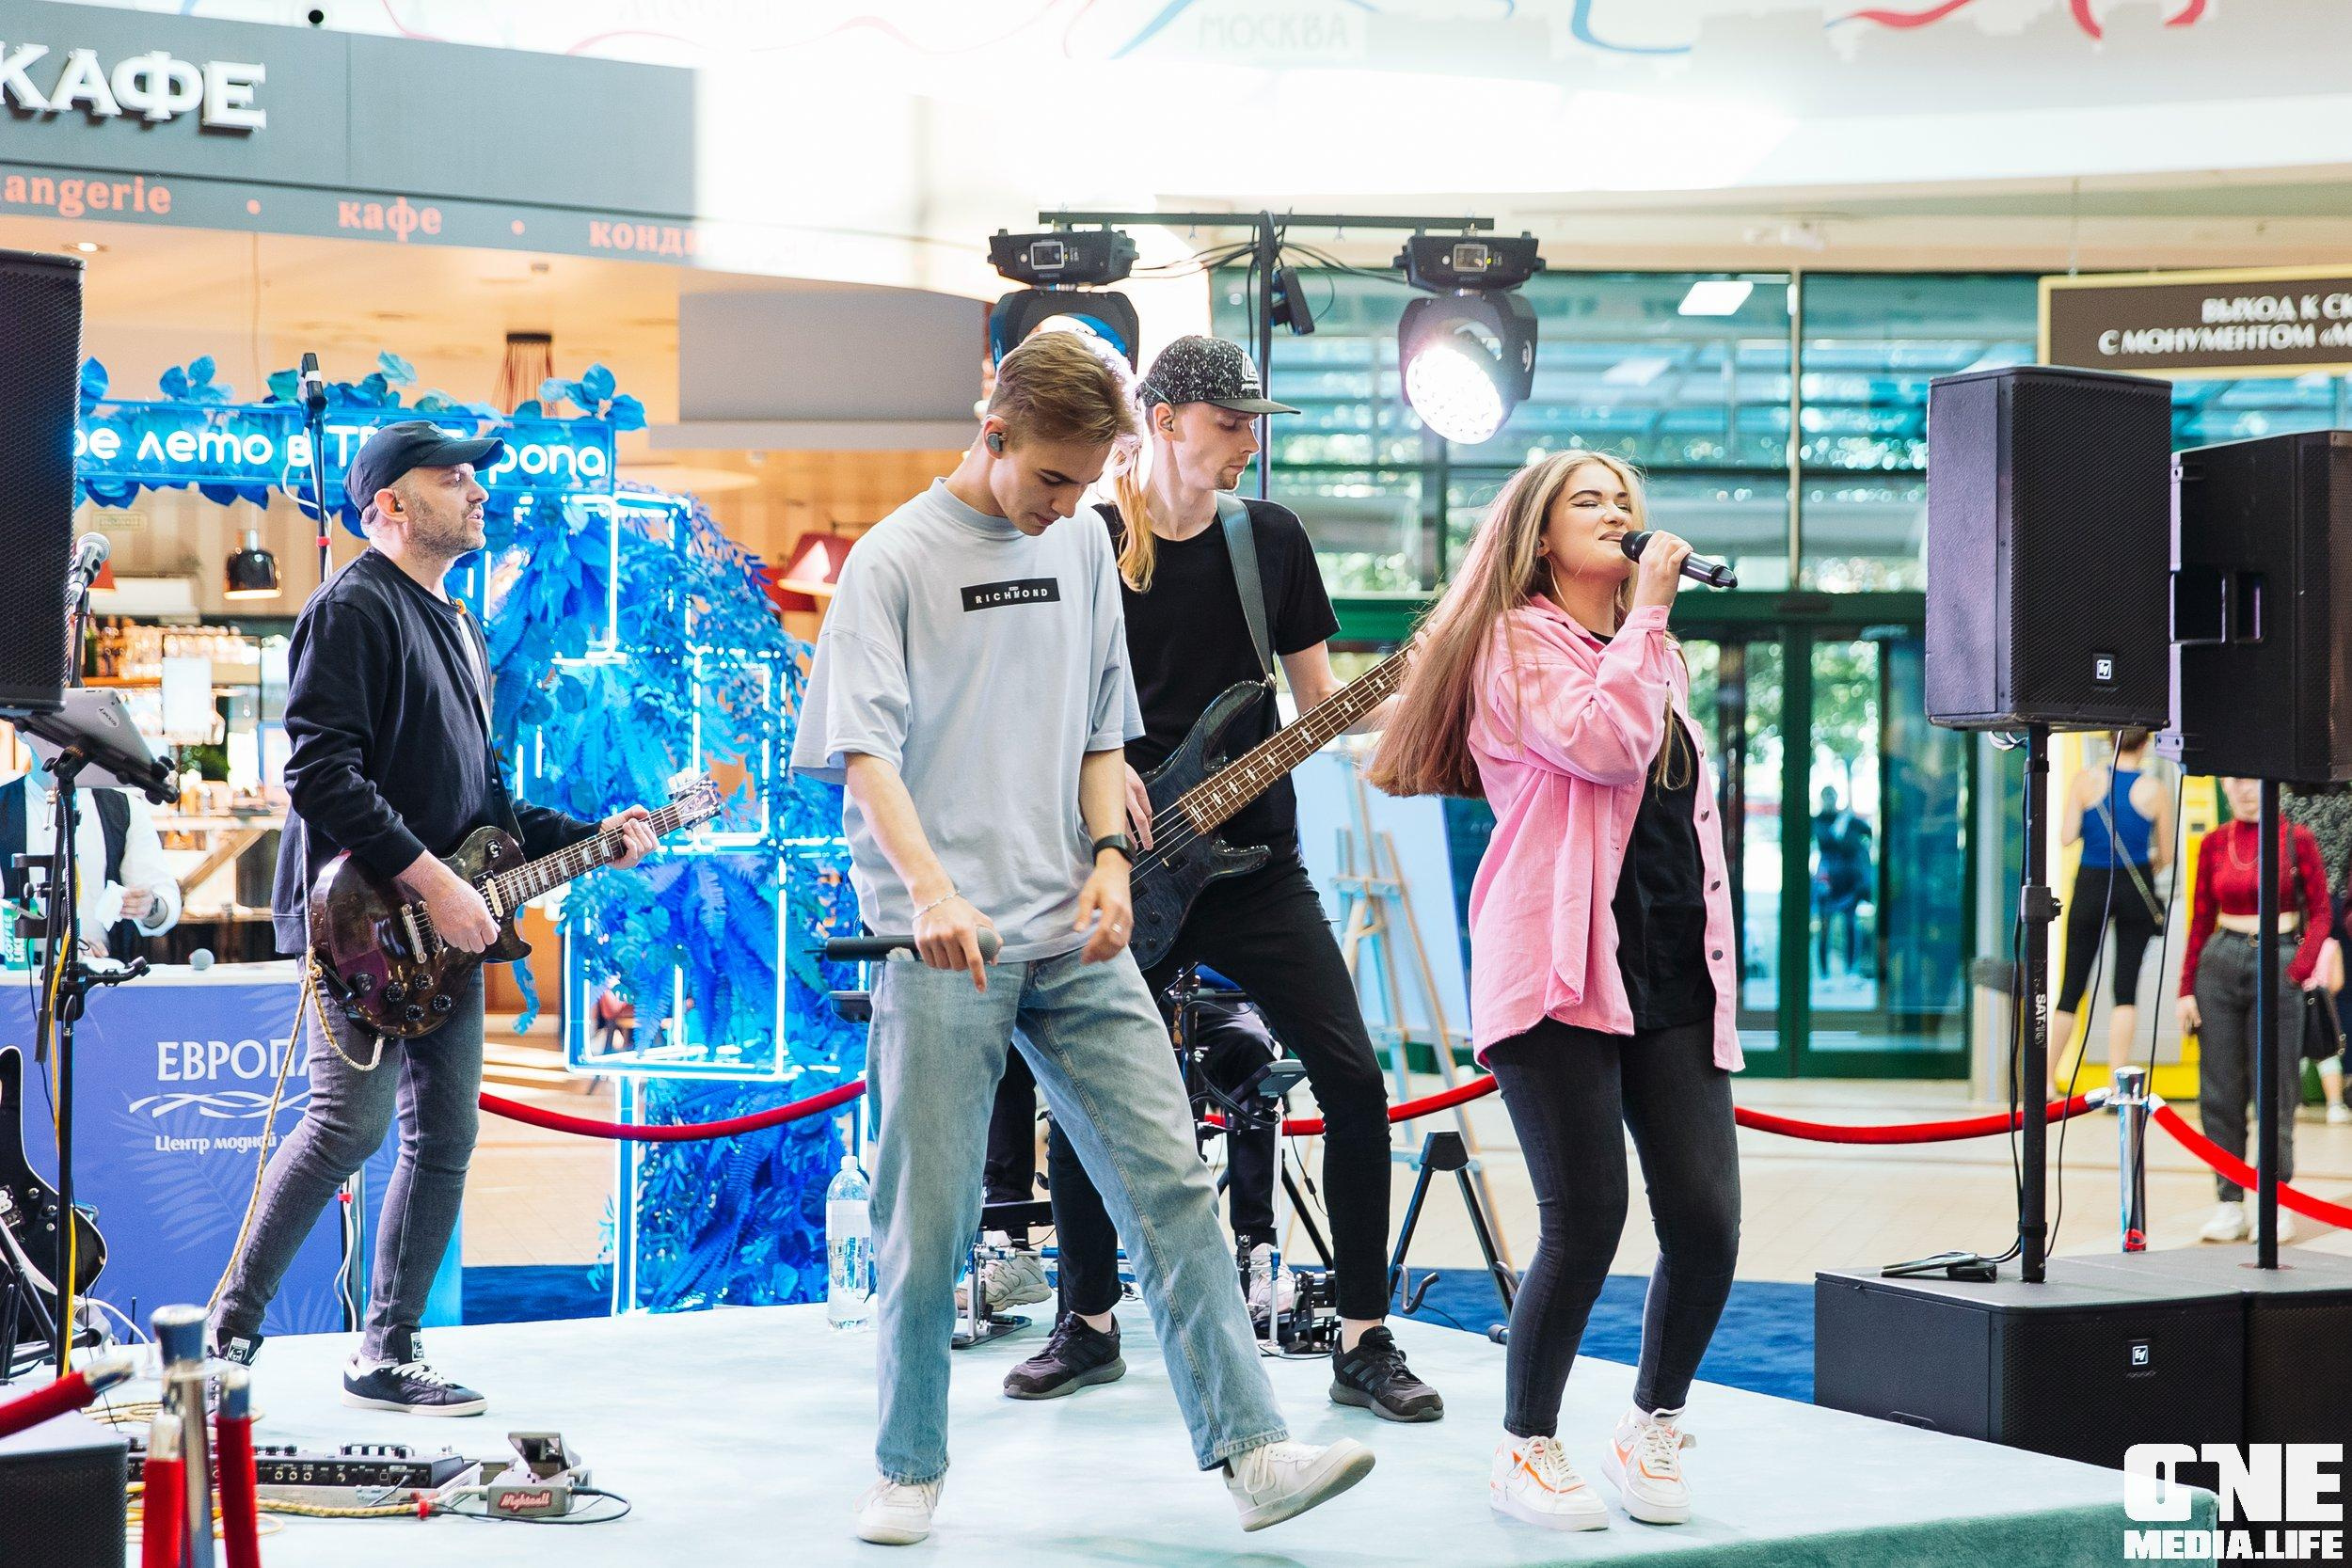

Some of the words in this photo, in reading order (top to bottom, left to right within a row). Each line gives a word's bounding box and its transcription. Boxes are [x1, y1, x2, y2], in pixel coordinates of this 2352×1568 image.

[1197, 12, 1349, 49] МОСКВА
[0, 40, 267, 132] КАФЕ
[4, 174, 172, 217] angerie
[338, 196, 443, 243] кафе
[2201, 294, 2297, 324] ВЫХОД
[2300, 293, 2320, 320] К
[2098, 329, 2120, 356] С
[2121, 324, 2316, 355] МОНУМЕНТОМ
[136, 429, 274, 466] лето
[287, 435, 312, 467] в
[975, 588, 1048, 604] RICHMOND
[155, 1134, 210, 1155] Центр
